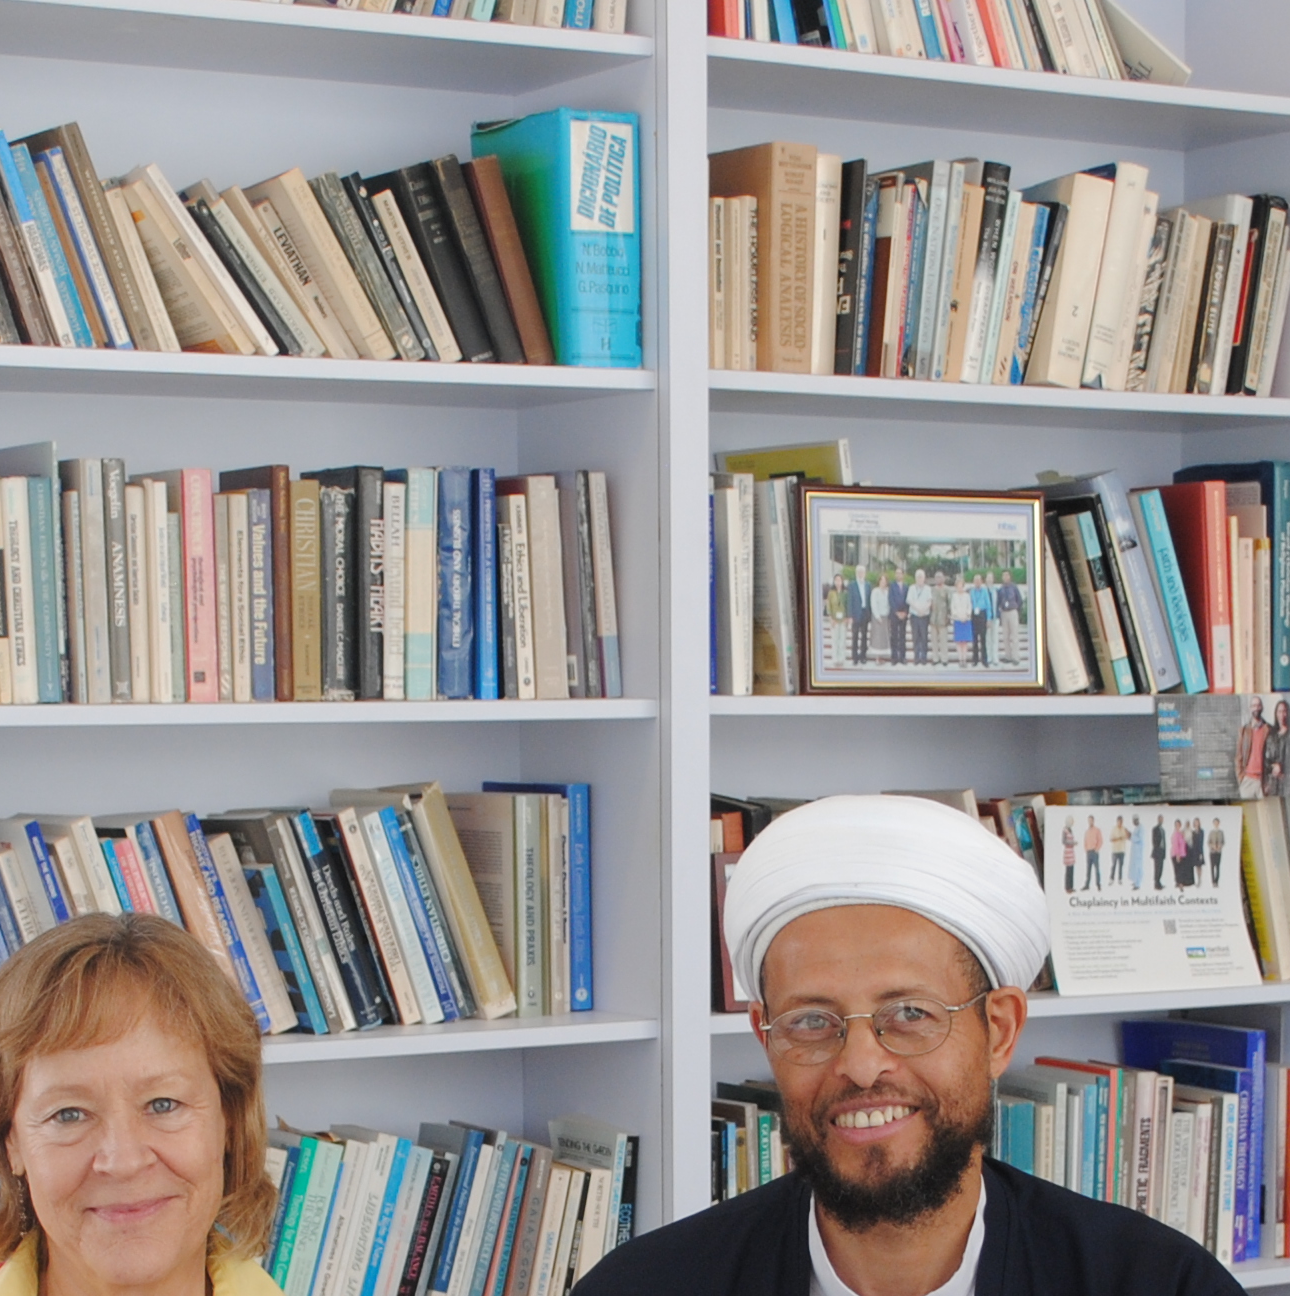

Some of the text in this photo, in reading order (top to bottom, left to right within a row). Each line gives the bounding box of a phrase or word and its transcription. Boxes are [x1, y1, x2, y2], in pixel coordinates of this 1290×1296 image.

[576, 125, 607, 220] DICIONÁRIO
[599, 135, 628, 230] DE POLÍTICA
[23, 223, 49, 272] HABERMAS
[778, 202, 792, 346] LOGICAL ANALYSIS
[794, 216, 807, 285] HISTORY
[1209, 264, 1227, 303] POWER
[107, 468, 125, 627] Voegelin ANAMNESIS
[294, 498, 317, 590] CHRISTIAN
[452, 509, 461, 647] ETHICAL THEORY AND BUSINESS
[514, 543, 526, 572] Ethics
[516, 575, 527, 593] and
[251, 524, 268, 664] Values and the Future
[517, 597, 529, 648] Liberation
[321, 864, 356, 952] Deeds and Rules
[408, 854, 451, 963] CHRISTIAN ETHICS
[525, 847, 535, 965] THEOLOGY AND PRAXIS
[1069, 894, 1219, 909] Chaplaincy in Multifaith Contexts
[1223, 1103, 1234, 1211] OUR COMMON FUTURE
